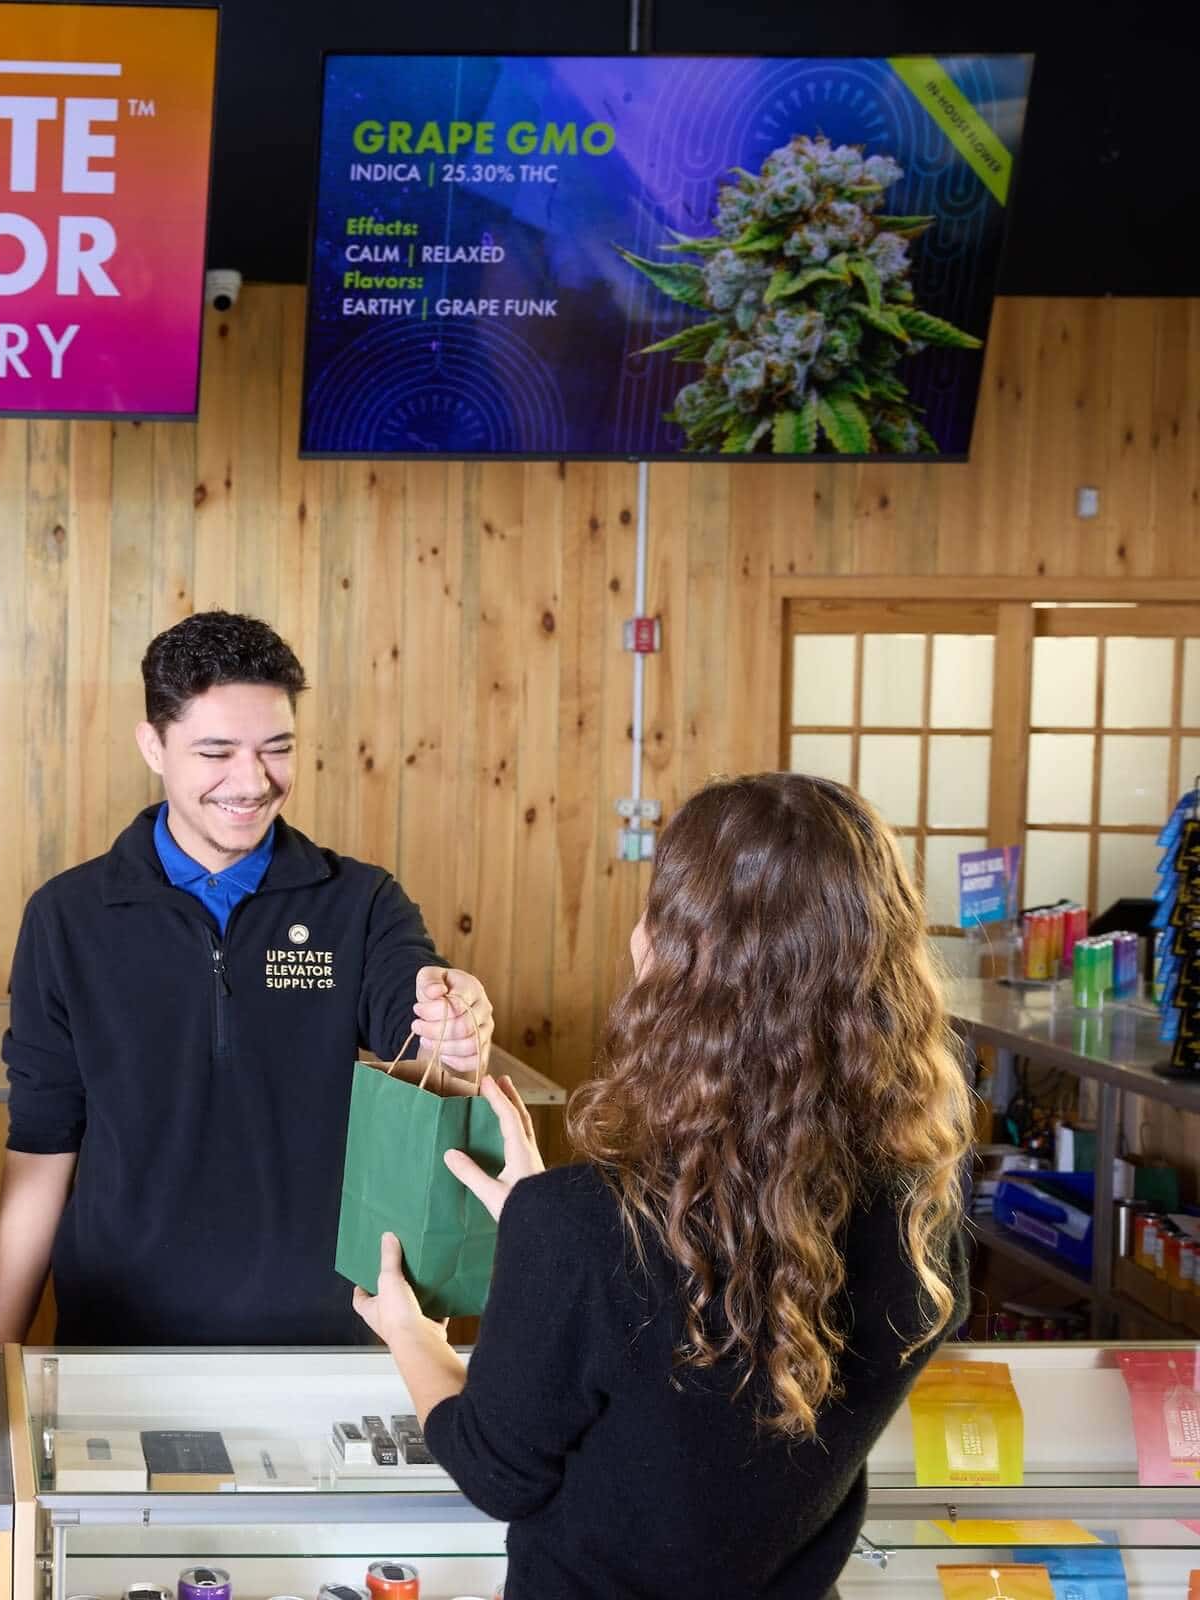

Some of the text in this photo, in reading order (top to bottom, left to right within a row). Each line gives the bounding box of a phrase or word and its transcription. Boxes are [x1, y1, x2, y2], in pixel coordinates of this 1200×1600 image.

[352, 120, 617, 156] GRAPE GMO
[350, 163, 421, 183] INDICA
[441, 164, 516, 183] 25.30%
[519, 165, 559, 183] THC
[345, 216, 419, 236] Effects:
[345, 245, 400, 263] CALM
[421, 245, 505, 263] RELAXED
[343, 270, 425, 289] Flavors:
[342, 298, 416, 316] EARTHY
[435, 299, 500, 317] GRAPE
[504, 299, 560, 317] FUNK
[266, 949, 334, 964] UPSTATE
[265, 964, 333, 977] ELEVATOR
[266, 978, 315, 989] SUPPLY
